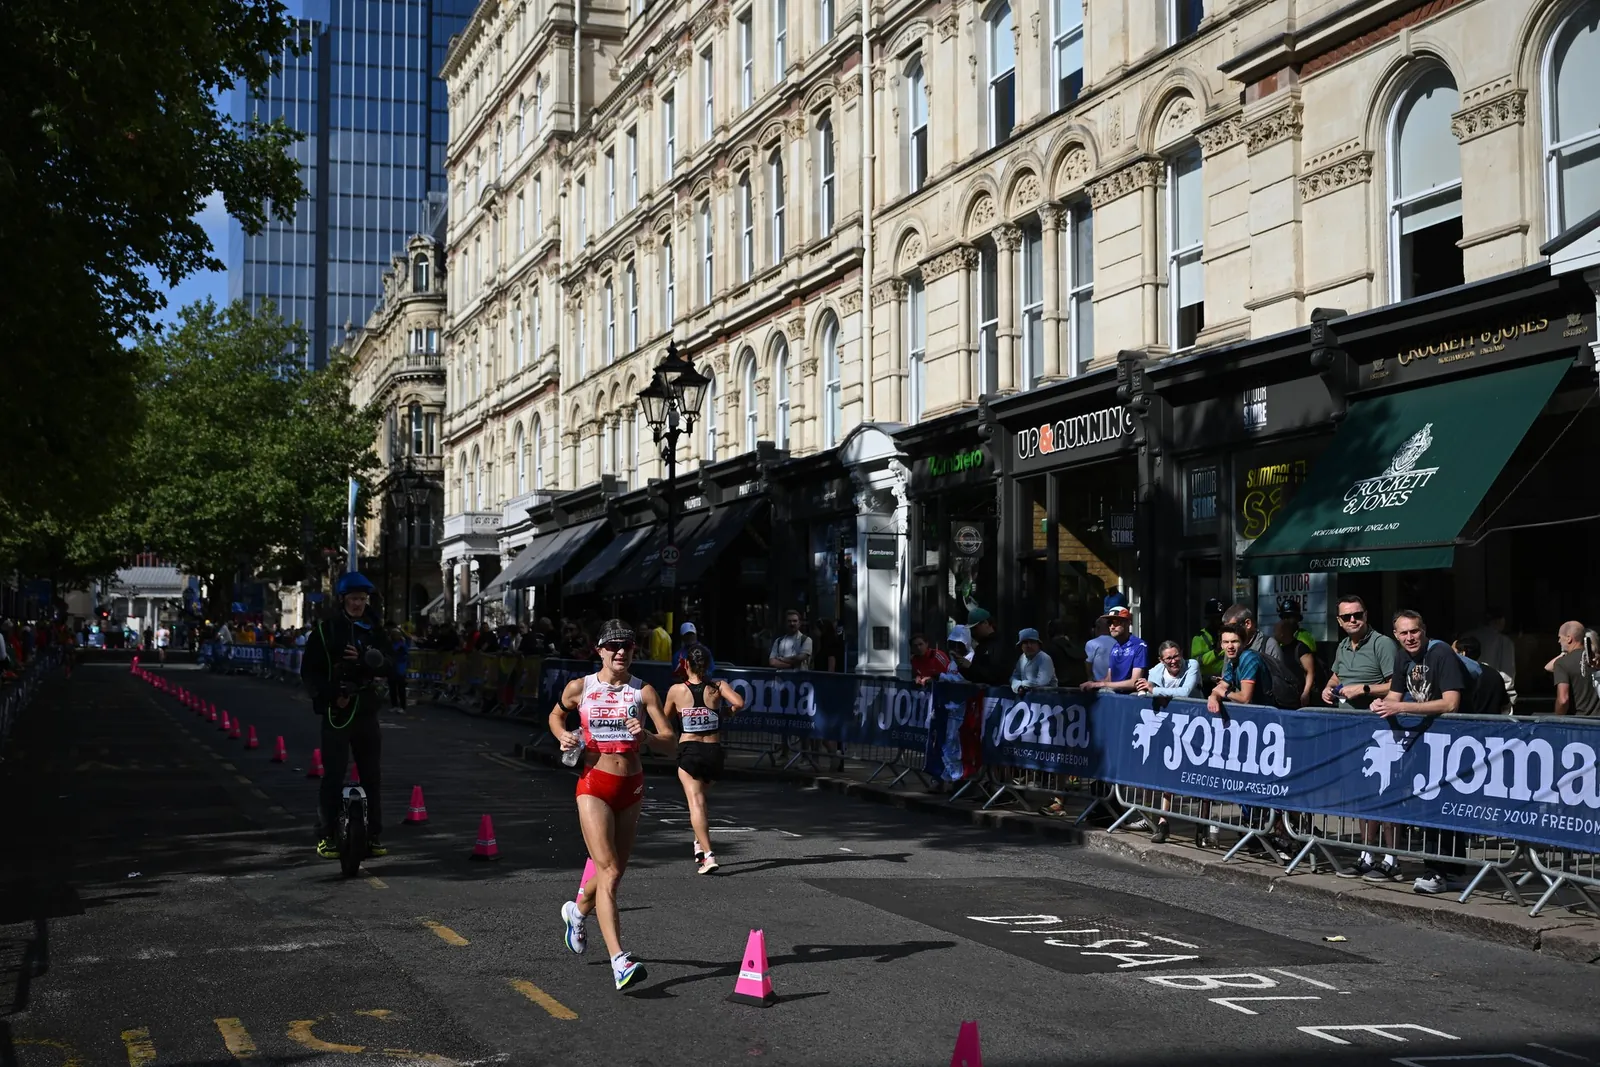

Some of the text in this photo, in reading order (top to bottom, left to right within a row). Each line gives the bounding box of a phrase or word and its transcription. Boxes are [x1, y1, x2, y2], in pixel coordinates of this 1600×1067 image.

[1243, 386, 1267, 404] LIQUOR
[1243, 402, 1267, 425] STORE
[1191, 470, 1217, 496] LIQUOR
[1246, 463, 1290, 488] summer
[1343, 470, 1437, 501] CROCKETT
[1192, 496, 1217, 519] STORE
[1110, 515, 1134, 529] LIQUOR
[1311, 522, 1400, 537] NORTHAMPTON ENGLAND
[1111, 530, 1134, 543] STORE
[663, 550, 679, 559] 20
[1309, 557, 1344, 570] CROCKETT
[1274, 574, 1310, 593] LIQUOR
[719, 677, 817, 717] oma
[590, 707, 627, 717] SPAR
[683, 708, 708, 716] SPAR
[877, 686, 933, 731] Jom
[589, 719, 596, 728] K
[690, 716, 710, 726] 518
[765, 717, 787, 726] YOUR
[992, 697, 1090, 749] Joma
[1163, 713, 1292, 778] Joma
[1034, 750, 1055, 763] YOUR
[1056, 753, 1089, 767] FREEDOM
[1412, 732, 1600, 809] Joma
[1180, 771, 1290, 797] EXERCISE YOUR FREEDOM
[1441, 802, 1501, 822] EXERCISE
[1503, 808, 1539, 826] YOUR
[966, 914, 1552, 1067] DISABLE
